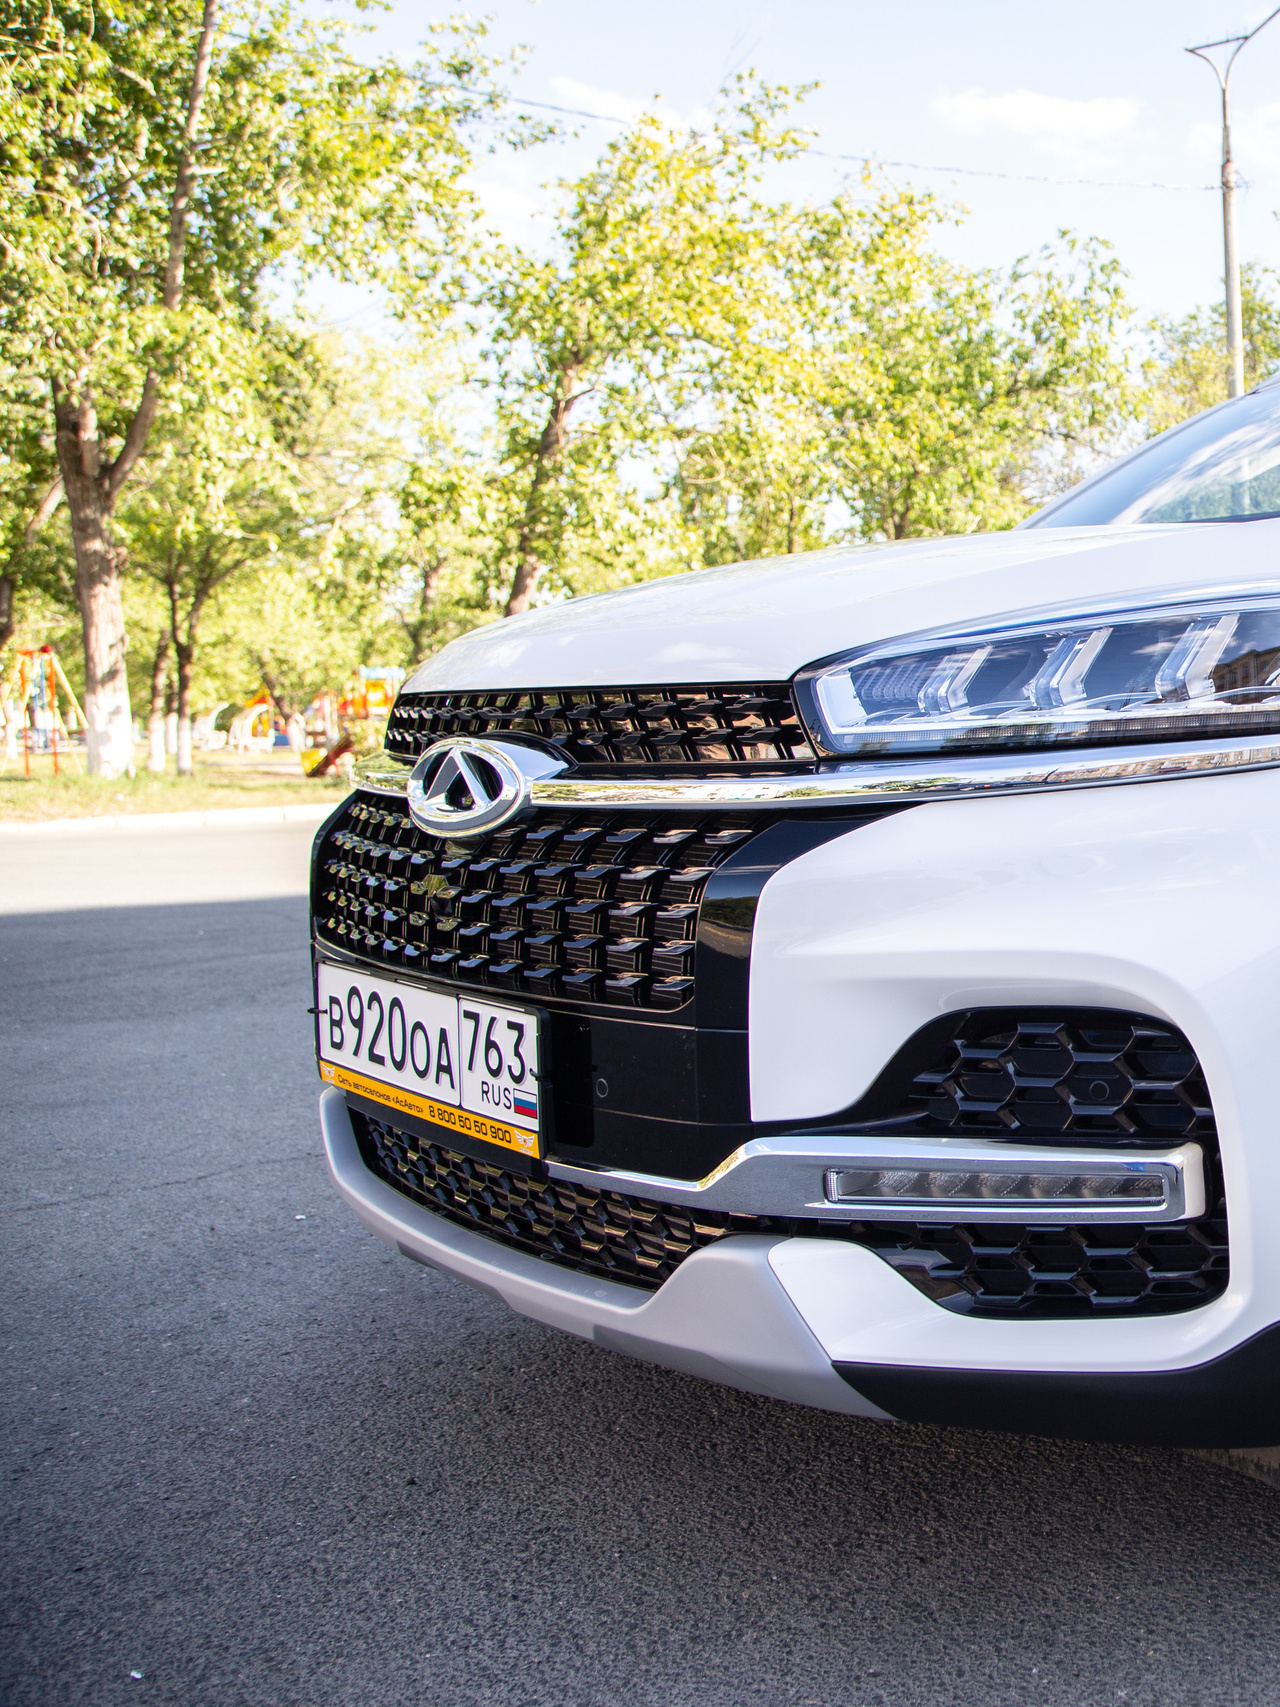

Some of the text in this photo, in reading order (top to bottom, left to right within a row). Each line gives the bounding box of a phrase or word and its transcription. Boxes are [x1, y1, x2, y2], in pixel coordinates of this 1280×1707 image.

[463, 1009, 527, 1085] 763
[481, 1080, 512, 1110] RUS
[428, 1105, 436, 1118] 8
[437, 1108, 457, 1126] 800
[458, 1114, 472, 1131] 50
[474, 1119, 488, 1136] 50
[489, 1125, 512, 1144] 900
